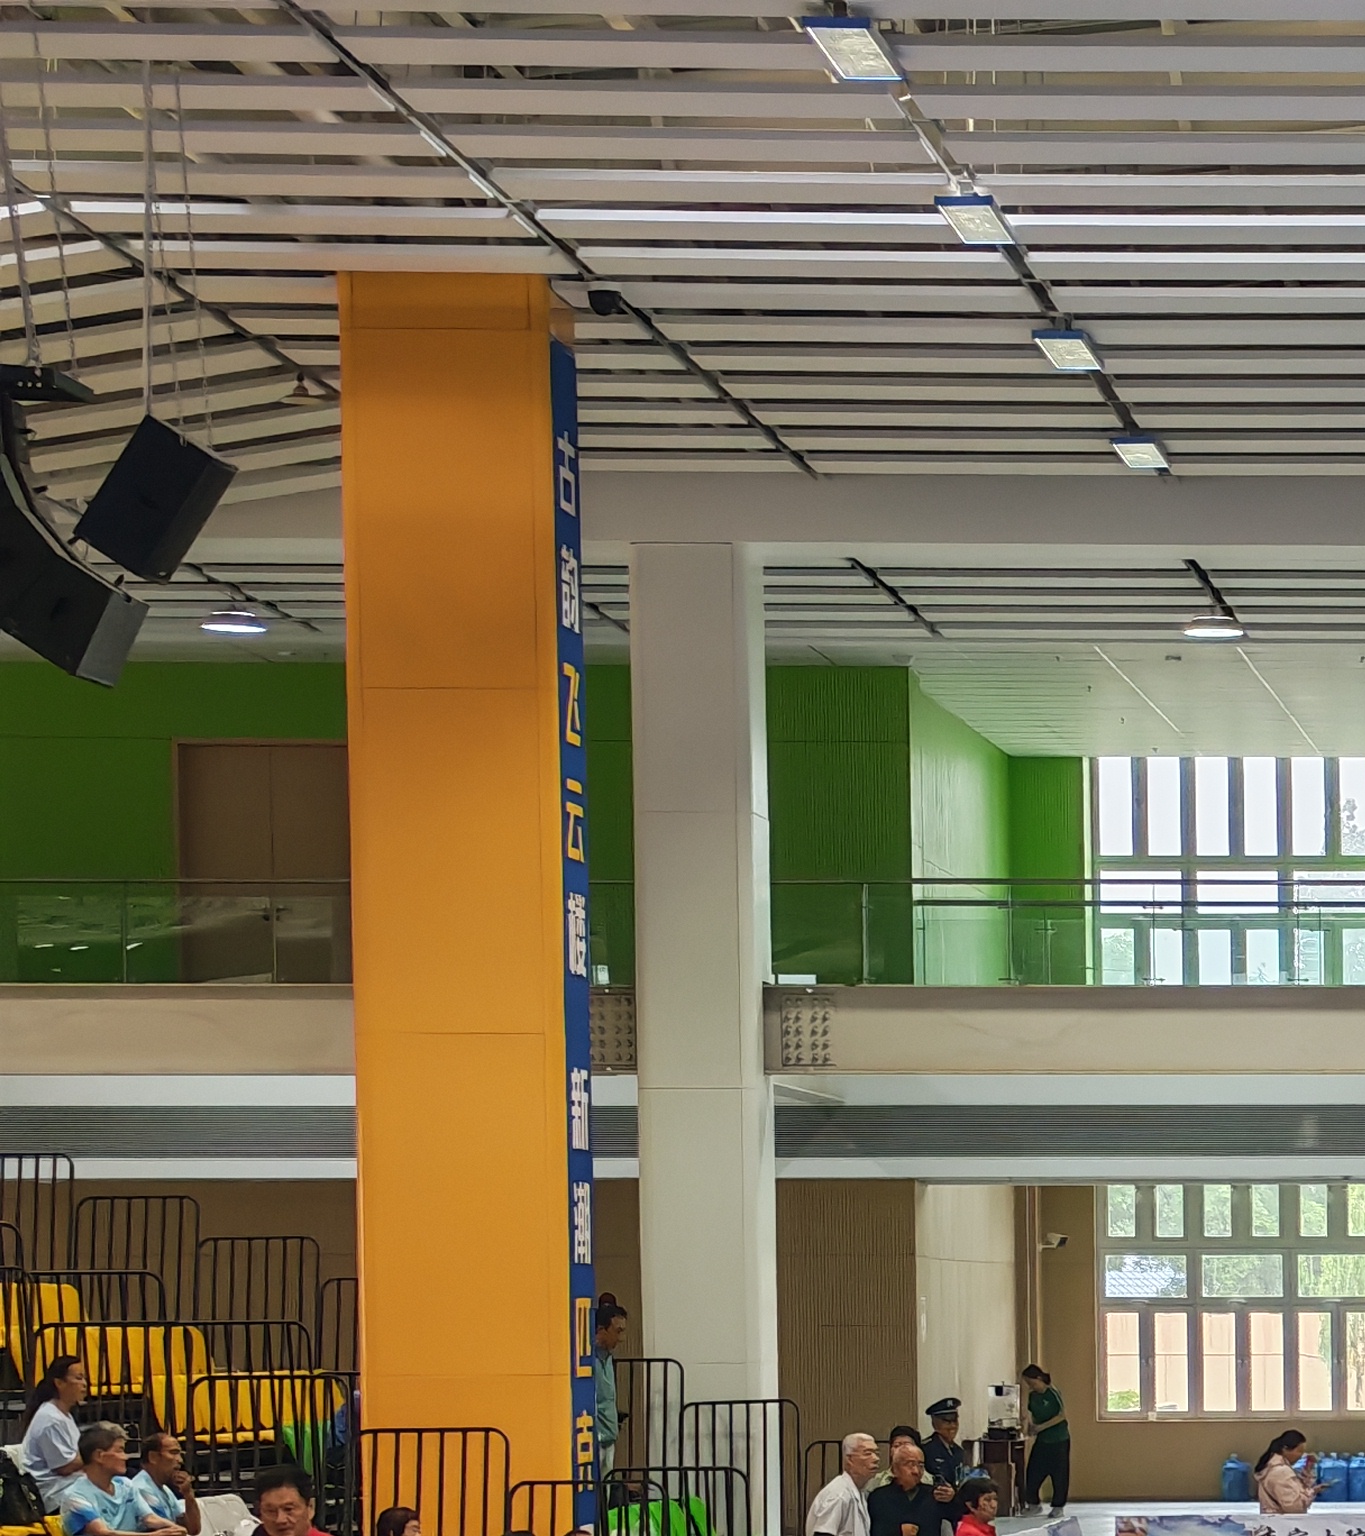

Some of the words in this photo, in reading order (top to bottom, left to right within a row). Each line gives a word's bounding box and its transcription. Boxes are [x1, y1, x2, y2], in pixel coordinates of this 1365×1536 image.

[556, 430, 588, 978] 古韵飞云楼
[570, 1067, 596, 1536] 新潮匹克
